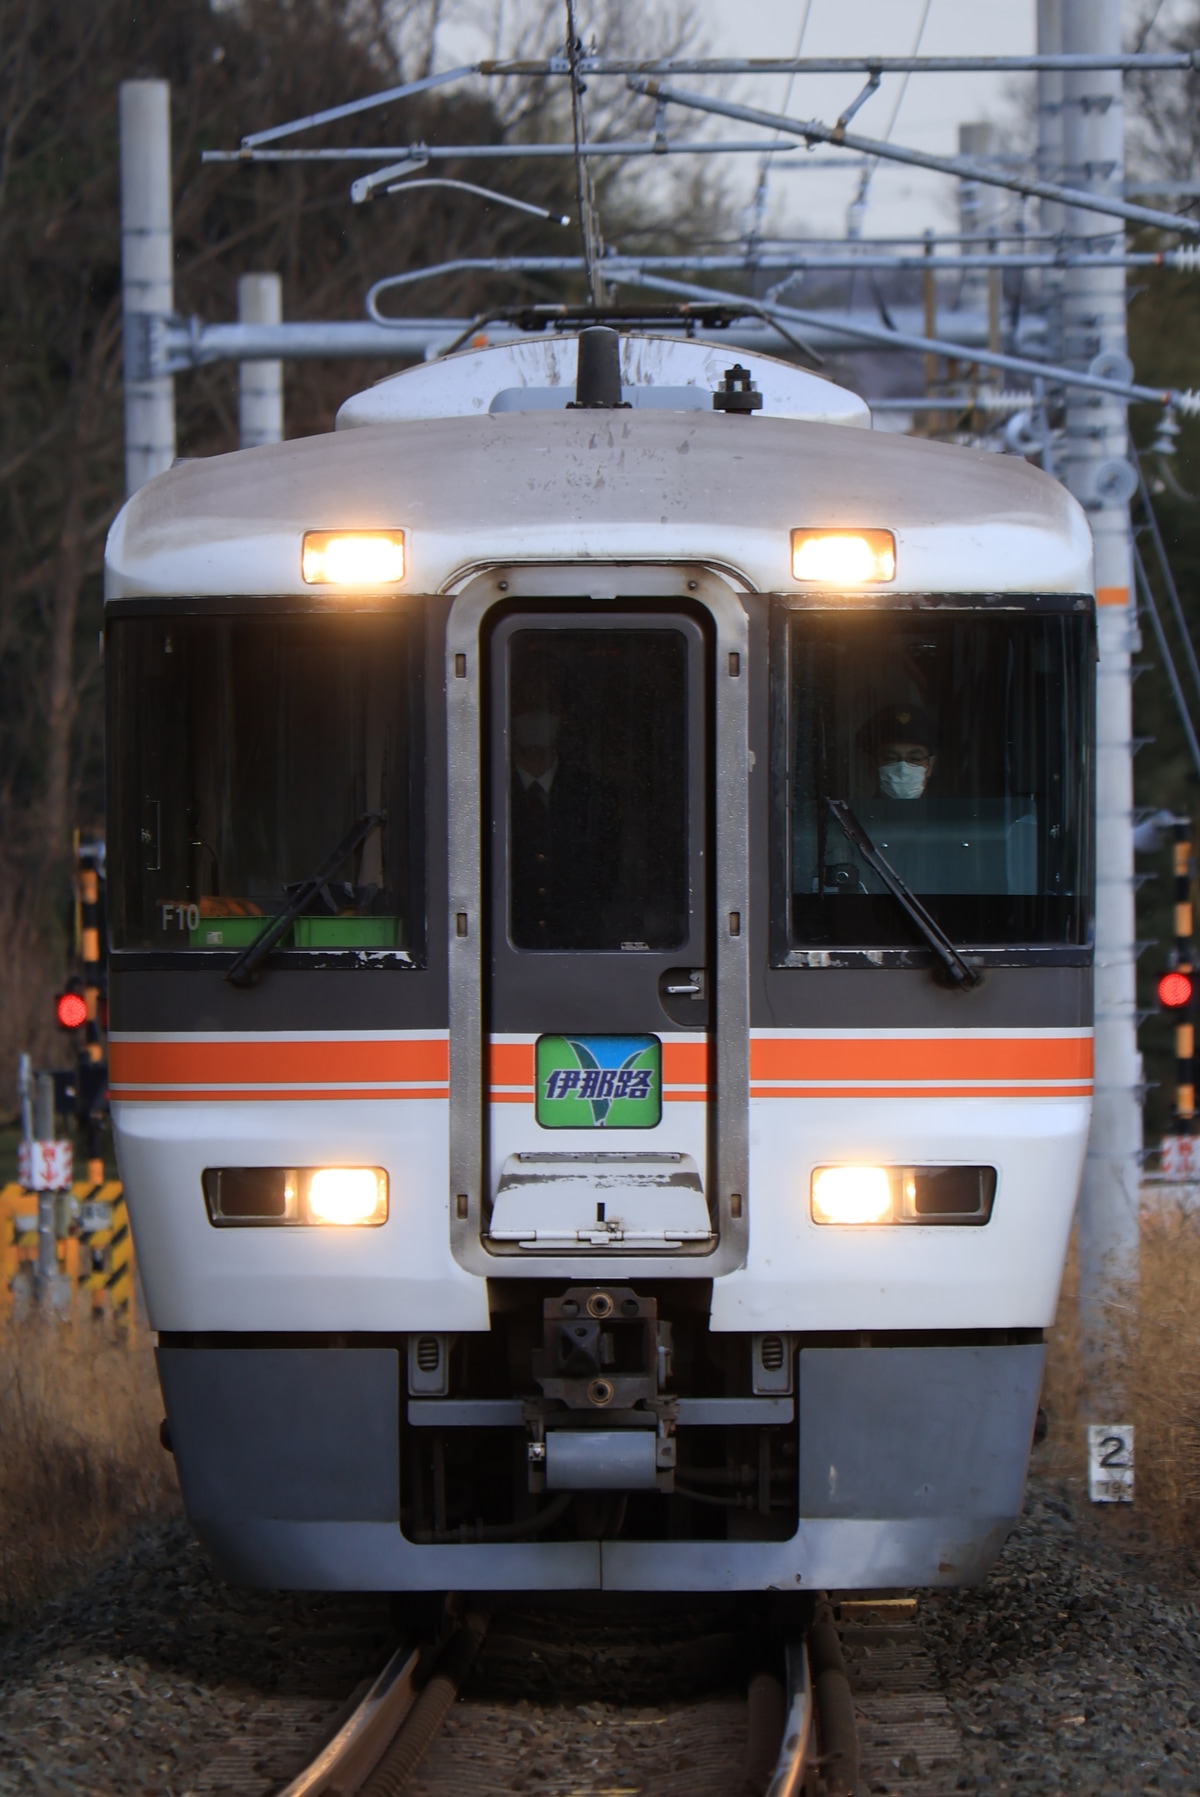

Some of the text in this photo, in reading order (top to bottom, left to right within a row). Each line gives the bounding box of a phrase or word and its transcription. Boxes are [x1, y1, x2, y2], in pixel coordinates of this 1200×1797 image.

[162, 904, 200, 931] F10
[544, 1069, 654, 1099] 伊那路
[1099, 1436, 1129, 1468] 2
